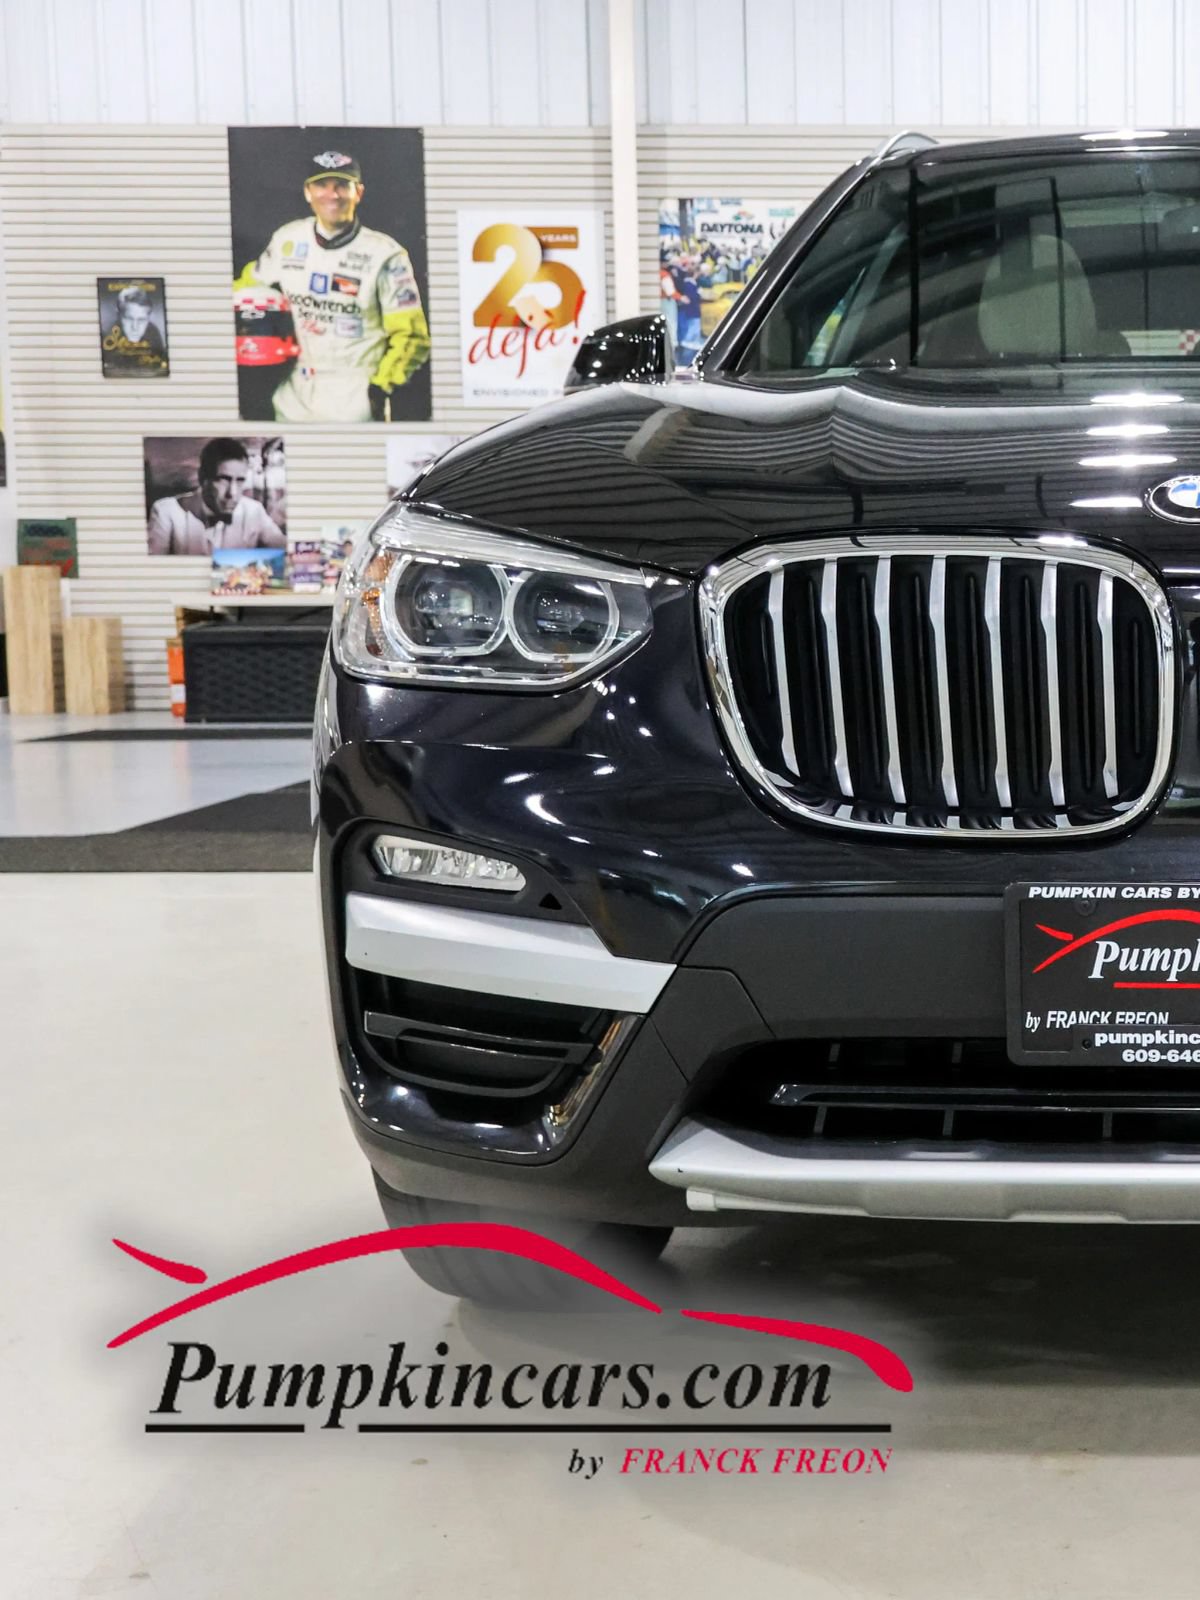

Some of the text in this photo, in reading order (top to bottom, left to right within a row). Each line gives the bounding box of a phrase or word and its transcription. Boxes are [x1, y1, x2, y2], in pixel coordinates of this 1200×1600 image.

[700, 222, 764, 234] DAYTONA
[1028, 886, 1117, 899] PUMPKIN
[1120, 886, 1173, 899] CARS
[1024, 1010, 1170, 1033] by FRANCK FREON
